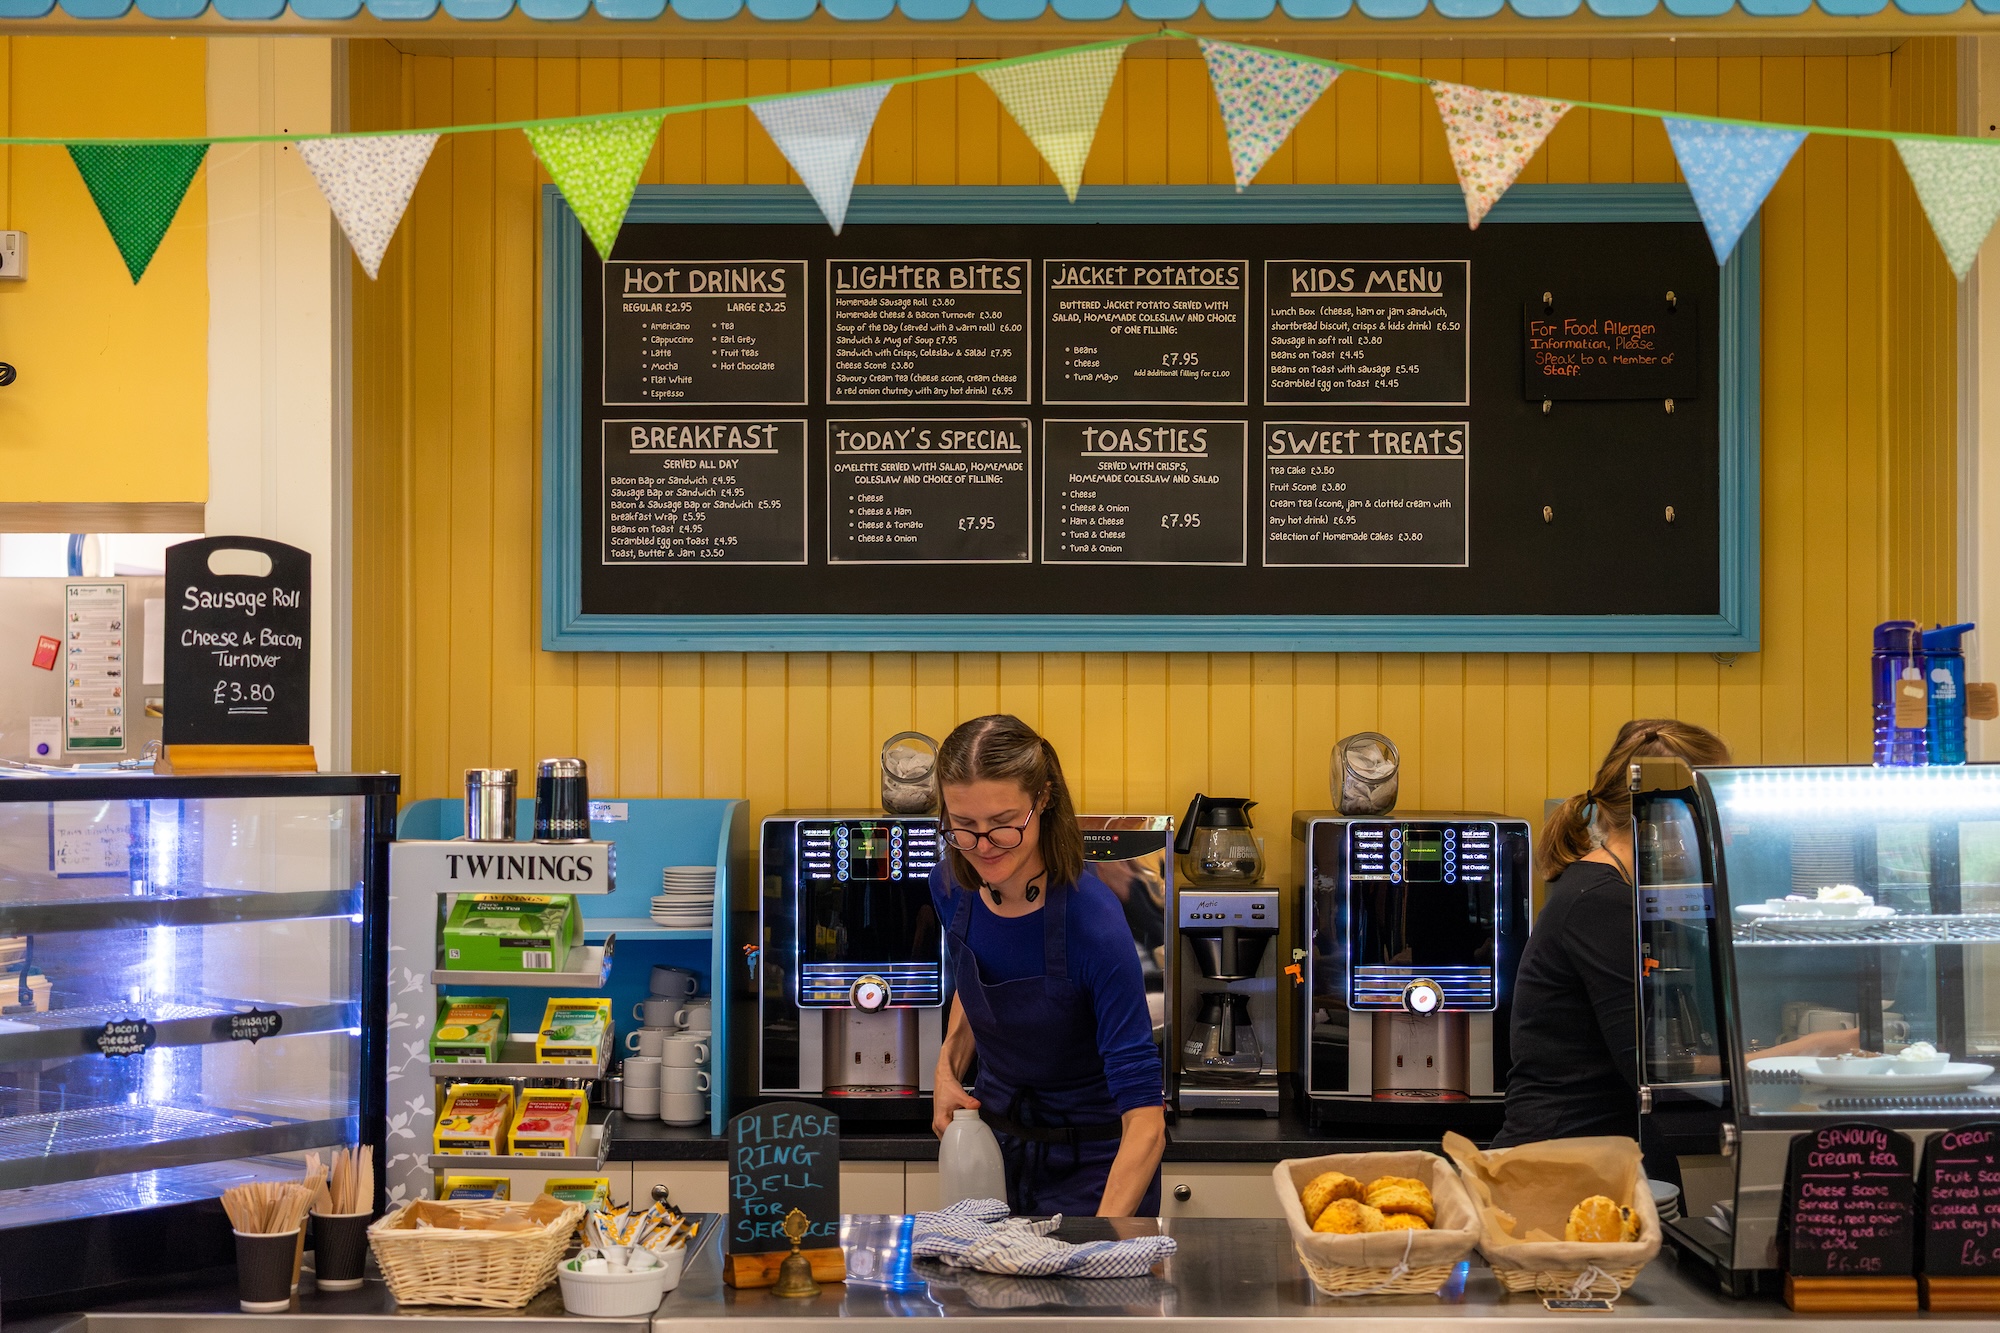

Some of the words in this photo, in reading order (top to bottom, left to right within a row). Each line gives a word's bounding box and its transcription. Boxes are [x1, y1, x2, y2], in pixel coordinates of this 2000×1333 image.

[624, 268, 680, 292] HOT
[690, 267, 785, 292] DRINKS
[838, 265, 940, 289] LIGHTER
[950, 265, 1021, 289] BITES
[1053, 264, 1127, 286] JACKET
[1134, 266, 1238, 285] POTATOES
[1292, 268, 1355, 291] KIDS
[1365, 267, 1442, 293] MENU
[623, 303, 662, 312] REGULAR
[665, 302, 692, 312] £2.95
[728, 303, 756, 311] LARGE
[759, 302, 786, 312] £3.25
[836, 298, 877, 306] Homemade
[880, 298, 911, 309] Sausage
[932, 298, 955, 306] £3.80
[1124, 325, 1141, 334] ONE
[1144, 326, 1177, 334] FILLING:
[1530, 320, 1557, 337] For
[1564, 318, 1598, 336] Food
[1604, 320, 1656, 342] Allergen
[651, 336, 693, 346] Cappuccino
[737, 336, 756, 345] Grey
[836, 336, 872, 344] Sandwich
[883, 337, 901, 347] Mug
[903, 335, 913, 344] of
[914, 336, 934, 347] Soup
[936, 336, 957, 344] £7.95
[1271, 337, 1305, 348] Sausage
[1318, 336, 1336, 344] soft
[1358, 336, 1382, 345] £3.80
[1530, 338, 1611, 351] Information,
[1615, 336, 1656, 350] Please
[1162, 353, 1198, 366] £7.95
[1581, 353, 1594, 365] to
[1598, 355, 1608, 365] a
[1660, 352, 1675, 365] of
[651, 362, 678, 370] Mocha
[737, 362, 774, 370] Chocolate
[892, 362, 914, 370] £3.80
[1095, 374, 1118, 383] Mayo
[651, 390, 684, 399] Espresso
[632, 424, 778, 448] BREAKFAST
[836, 427, 931, 450] TODAY'S
[938, 430, 1021, 449] SPECIAL
[1082, 427, 1207, 452] TOASTIES
[1268, 430, 1360, 454] SWEET
[1368, 430, 1462, 454] TREATS
[663, 459, 696, 468] SERVED
[700, 460, 716, 468] ALL
[719, 459, 739, 468] DAY
[1098, 461, 1127, 470] SERVED
[1130, 462, 1154, 470] WITH
[1156, 462, 1188, 472] CRISPS,
[1322, 483, 1346, 492] £3.80
[611, 512, 652, 521] Breakfast
[654, 512, 678, 523] Wrap
[683, 512, 706, 521] £5.95
[959, 517, 995, 531] £7.95
[1161, 514, 1200, 528] £7.95
[1270, 532, 1308, 540] Selection
[1310, 532, 1320, 540] of
[1323, 532, 1368, 540] Homemade
[1370, 532, 1393, 540] Cakes
[1398, 533, 1422, 541] £3.80
[69, 588, 78, 596] 14
[182, 586, 267, 616] Sausage
[272, 587, 301, 609] Roll
[181, 628, 239, 647] Cheese
[260, 628, 302, 650] Bacon
[211, 650, 281, 668] Turnover
[213, 680, 275, 704] £3.80
[446, 854, 593, 882] TWININGS
[231, 1014, 276, 1034] Sausage
[738, 1114, 839, 1144] PLEASE
[738, 1144, 820, 1172] RING
[730, 1172, 824, 1200] BELL
[741, 1196, 786, 1216] FOR
